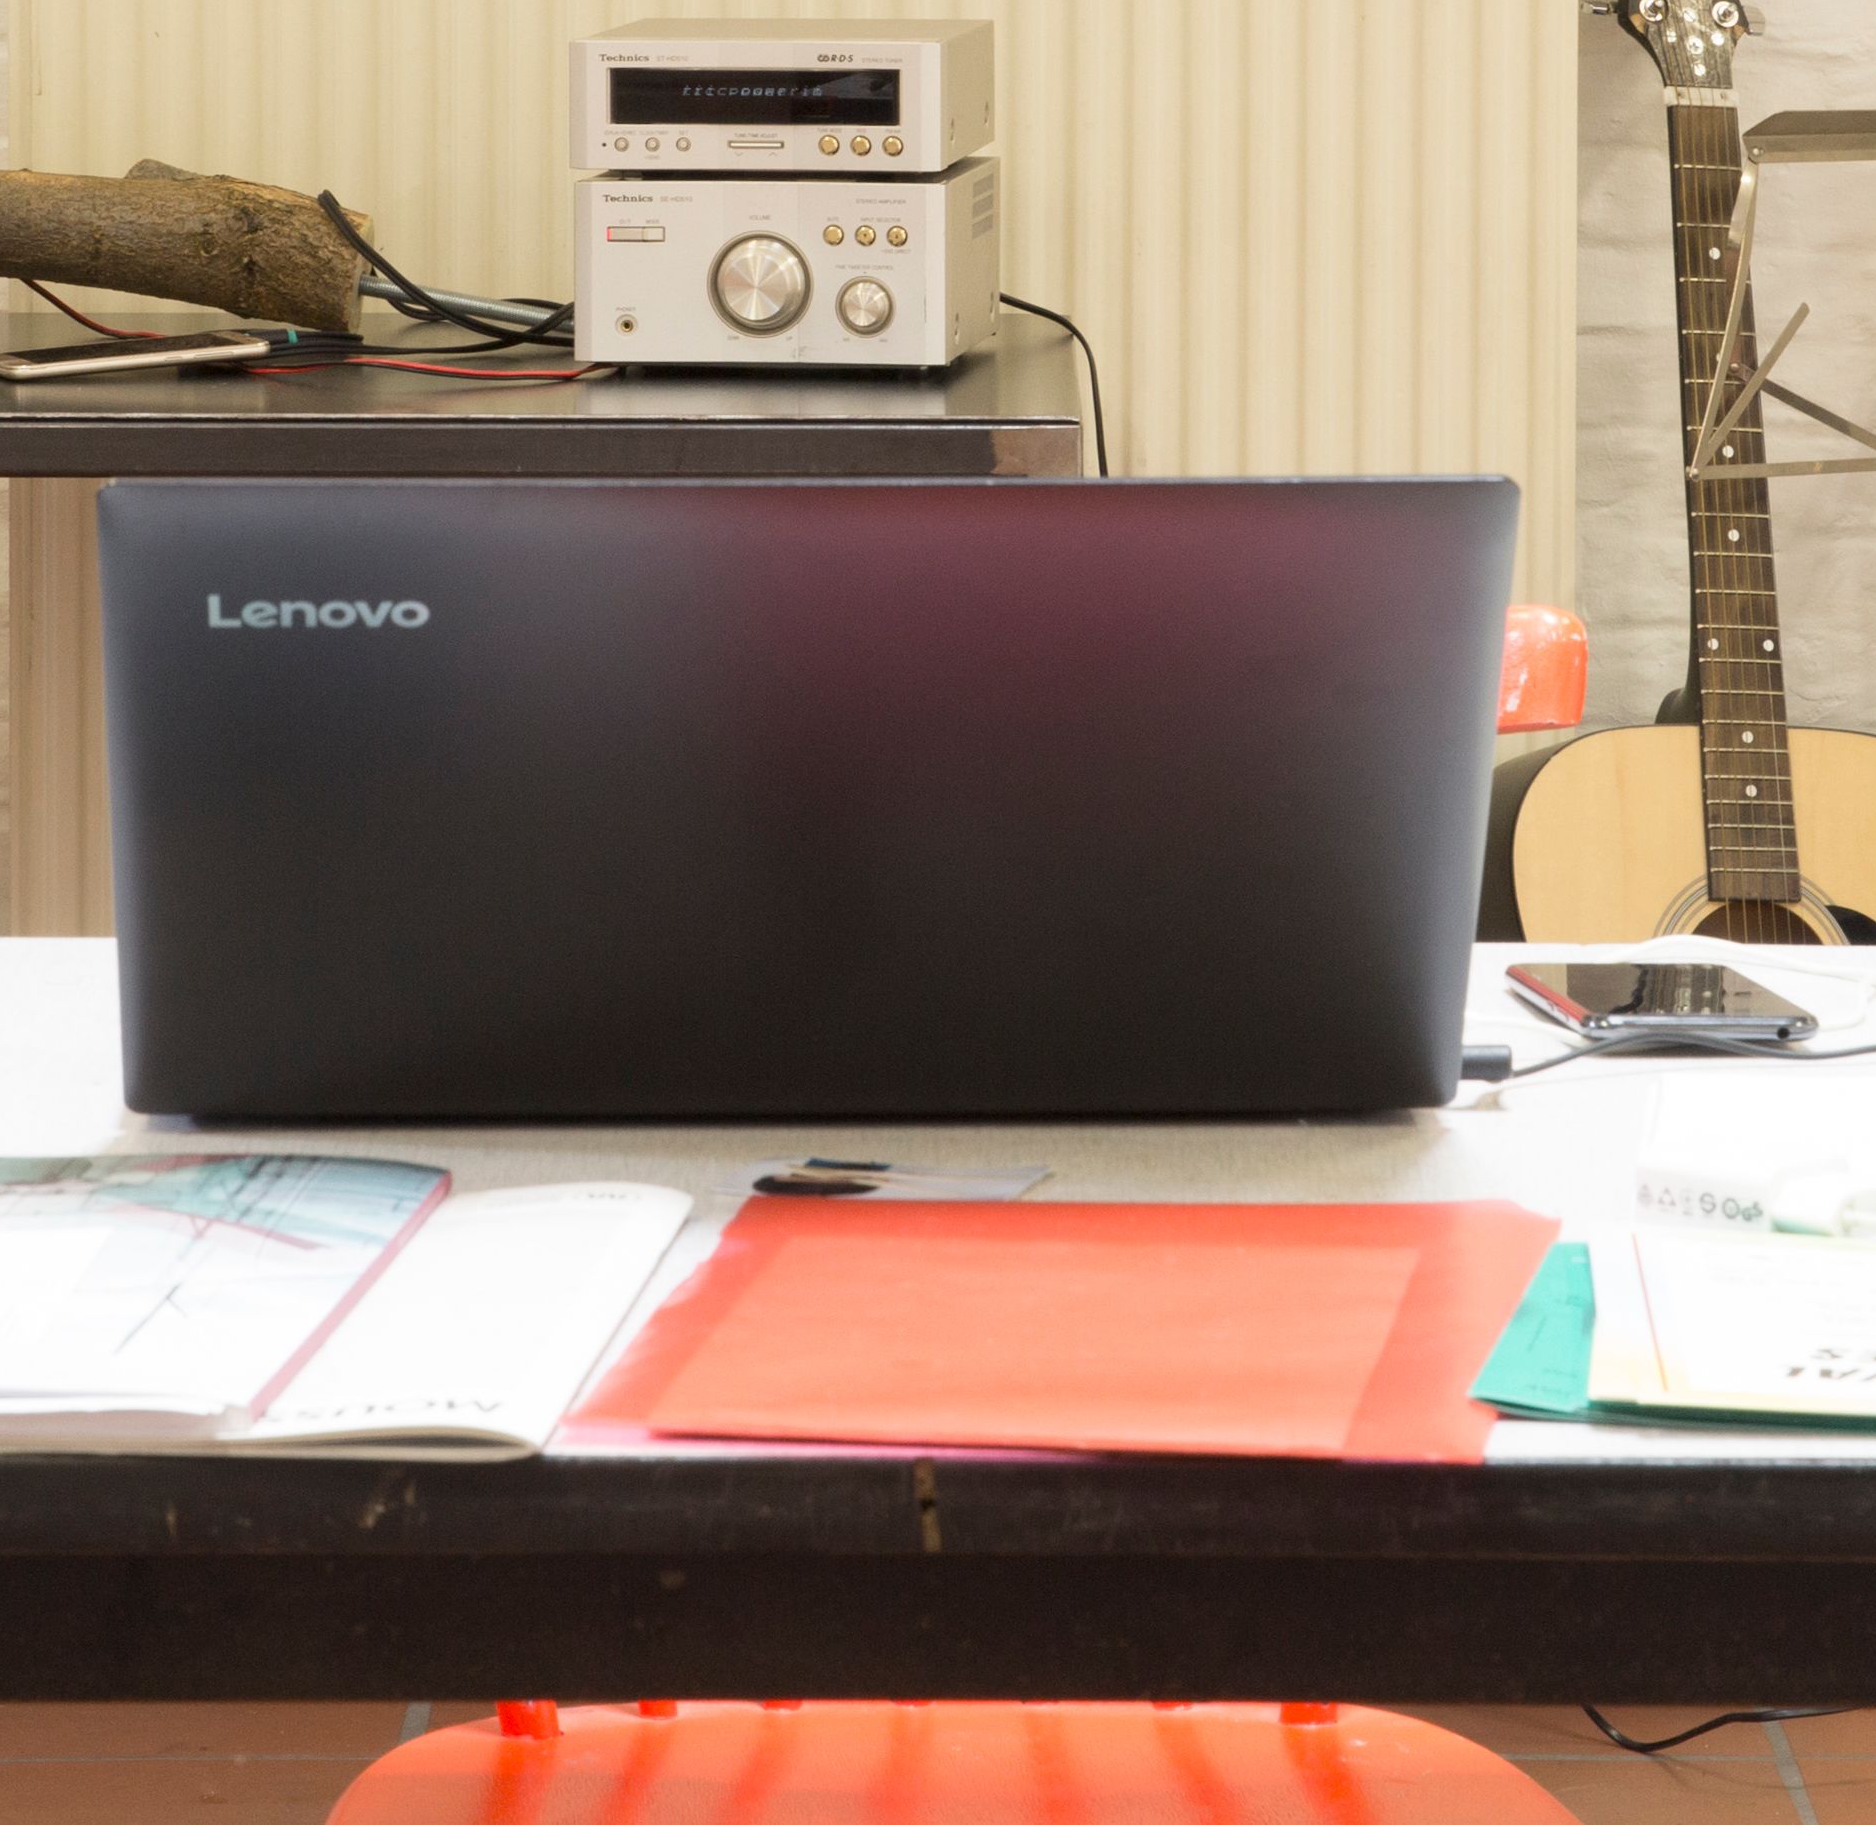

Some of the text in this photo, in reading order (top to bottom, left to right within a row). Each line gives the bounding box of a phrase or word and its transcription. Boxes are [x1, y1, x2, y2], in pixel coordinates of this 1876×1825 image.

[599, 53, 650, 62] Technics
[602, 193, 653, 202] Technics
[207, 593, 430, 627] Lenovo
